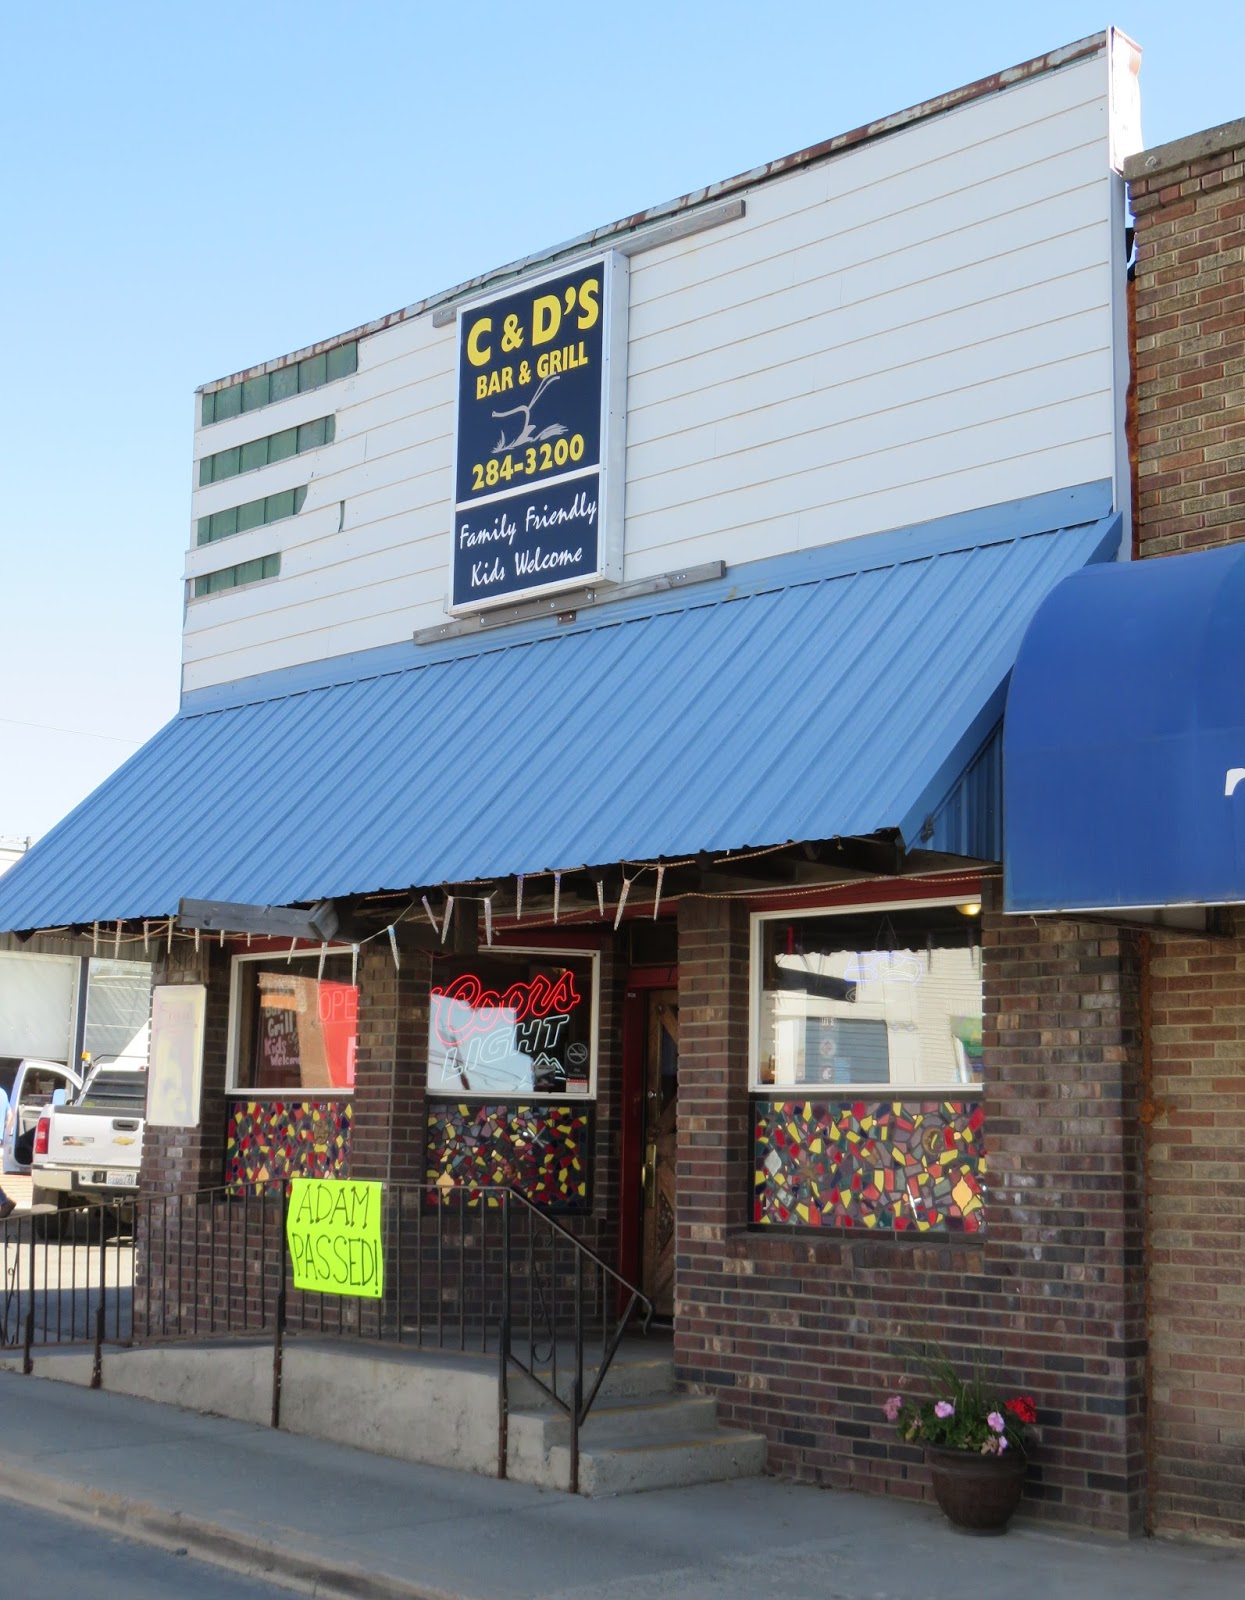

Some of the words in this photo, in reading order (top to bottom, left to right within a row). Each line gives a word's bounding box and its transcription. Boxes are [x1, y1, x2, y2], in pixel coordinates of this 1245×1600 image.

[467, 317, 492, 367] C
[501, 313, 524, 352] &
[532, 278, 599, 347] D'S
[476, 365, 513, 401] BAR
[518, 360, 532, 385] &
[536, 341, 588, 380] GRILL
[472, 433, 585, 491] 284-3200
[460, 513, 516, 550] Family
[525, 491, 597, 533] Friendly
[471, 556, 505, 587] Kids
[514, 546, 583, 576] Welcome
[267, 1010, 294, 1037] Grill
[320, 989, 356, 1021] OPE
[430, 970, 581, 1046] Coors
[264, 1035, 287, 1056] Kids
[441, 1013, 570, 1083] LIGHT
[296, 1183, 370, 1229] ADAM
[292, 1232, 379, 1295] PASSED!
